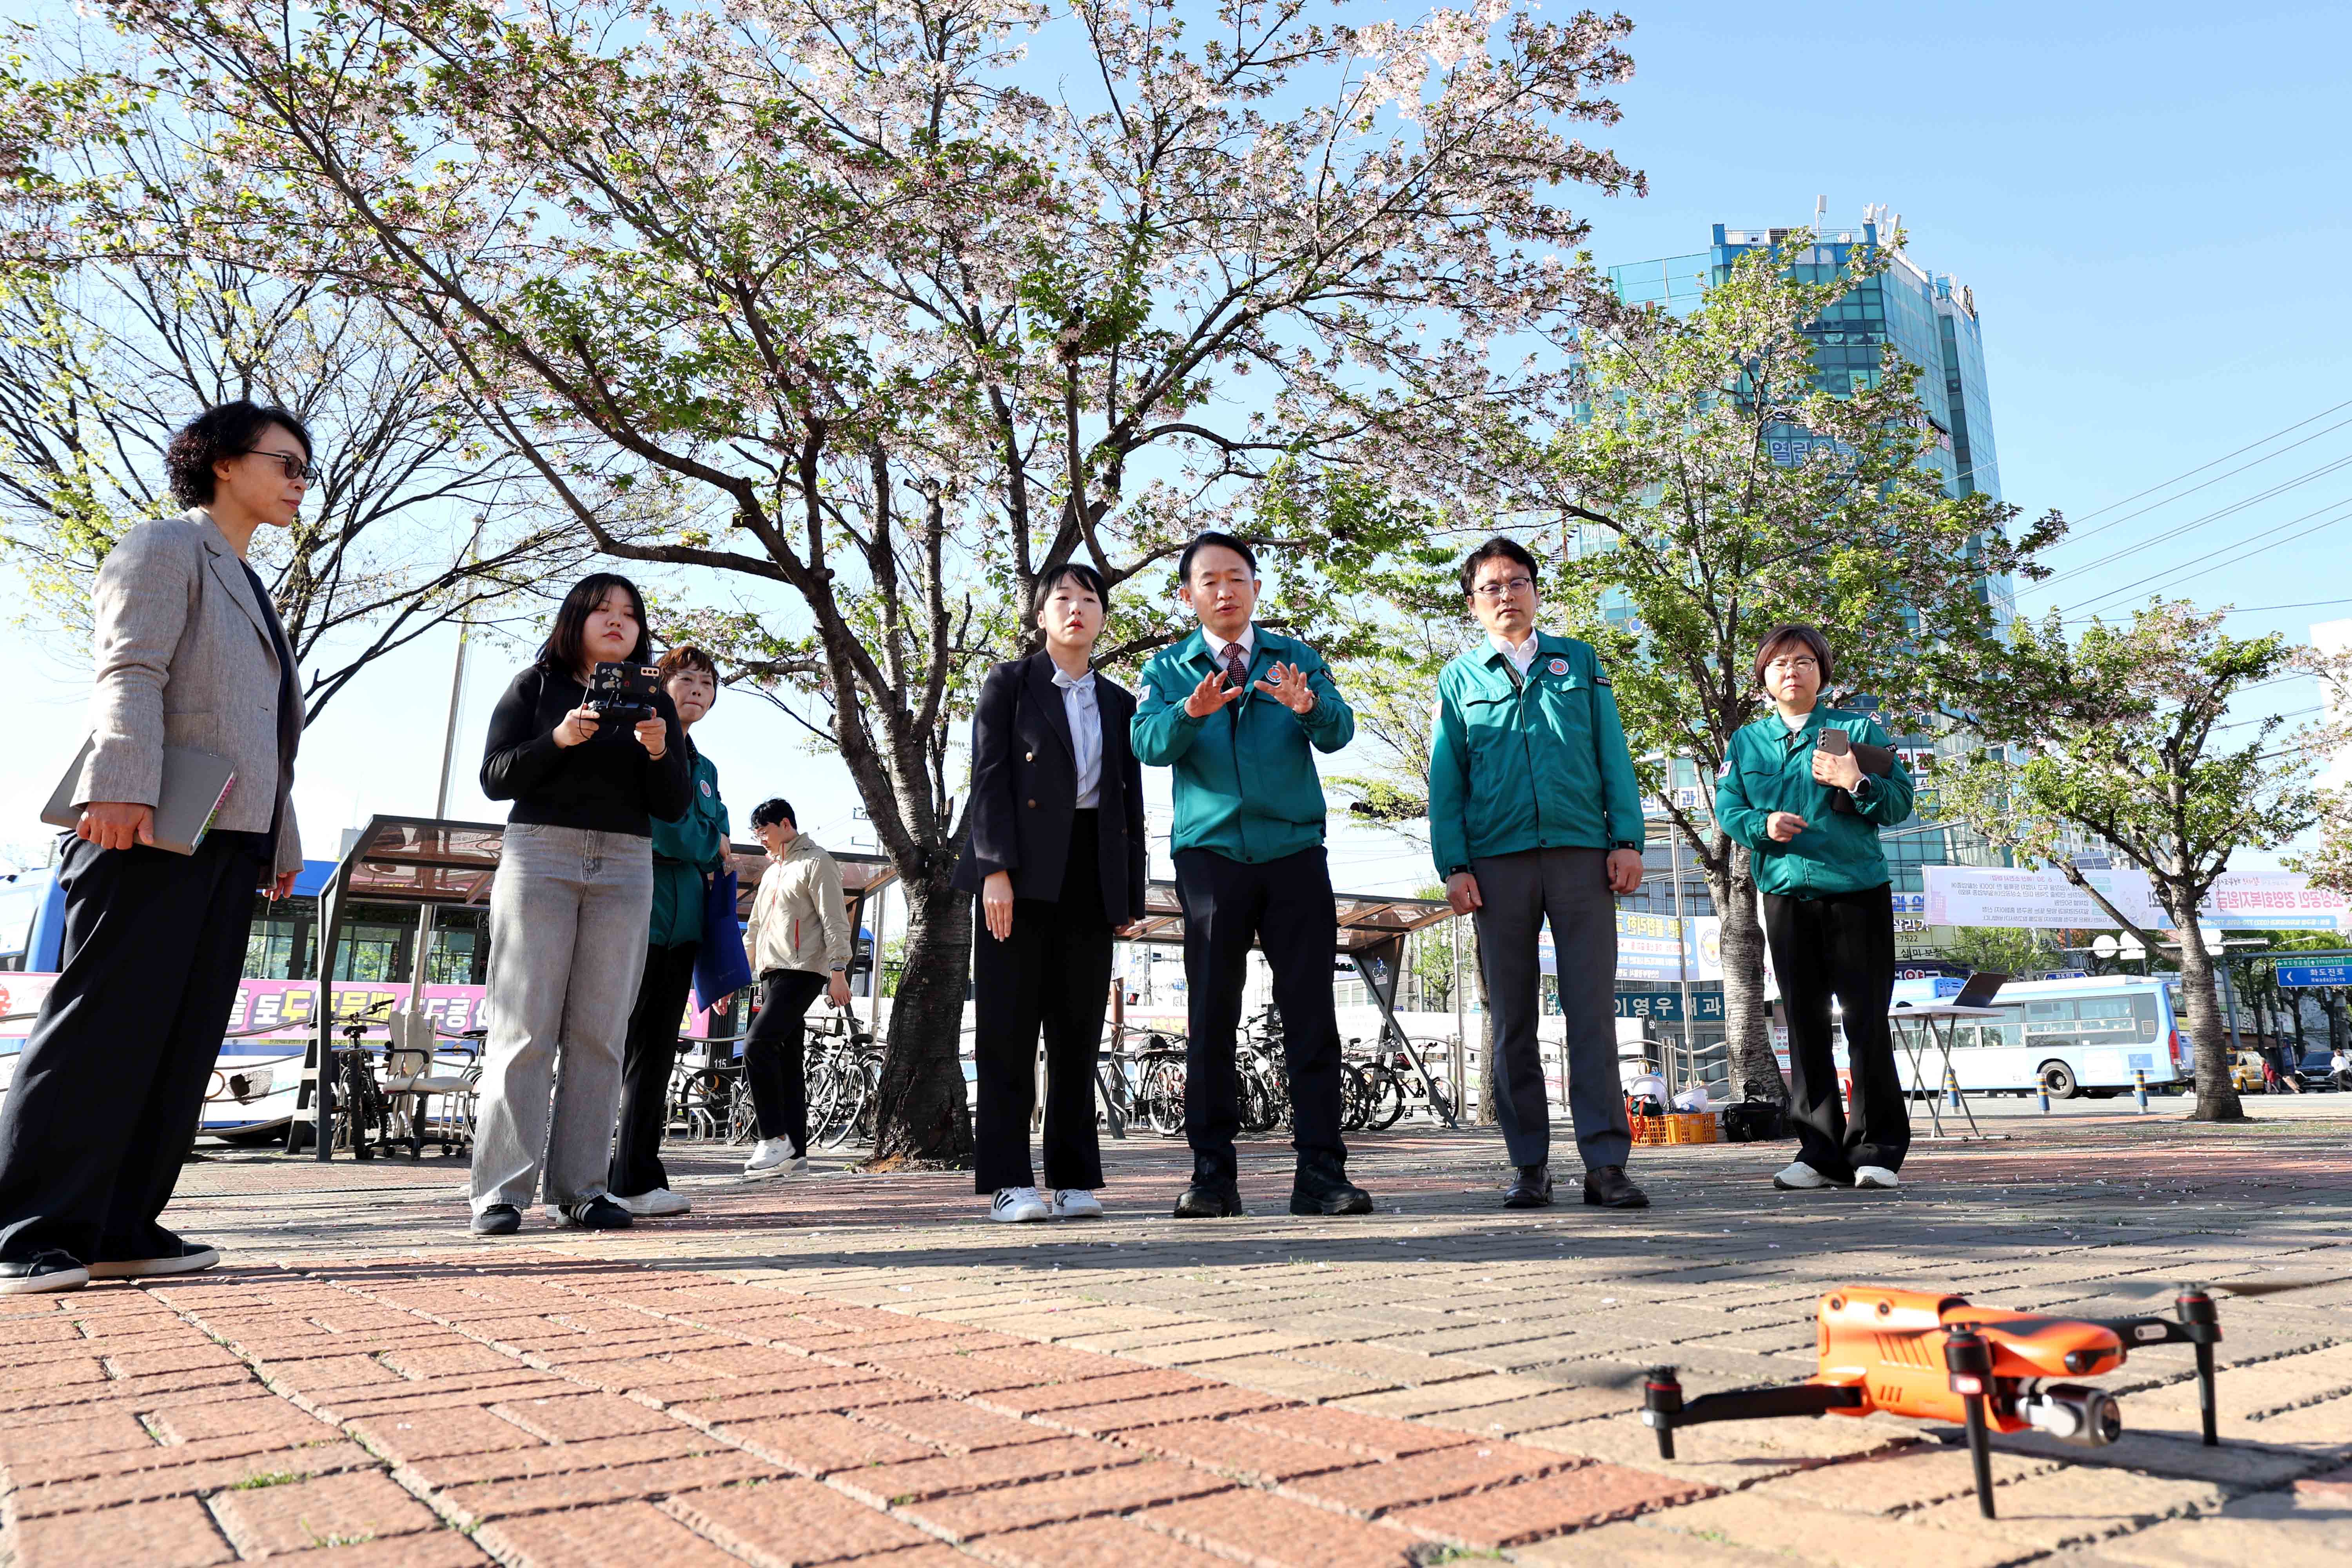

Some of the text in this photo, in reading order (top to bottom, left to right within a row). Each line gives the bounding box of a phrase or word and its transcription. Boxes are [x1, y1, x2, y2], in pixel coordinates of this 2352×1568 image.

[2310, 968, 2345, 976] 화도진로
[1648, 1020, 1655, 1029] 52
[714, 1059, 727, 1068] 115
